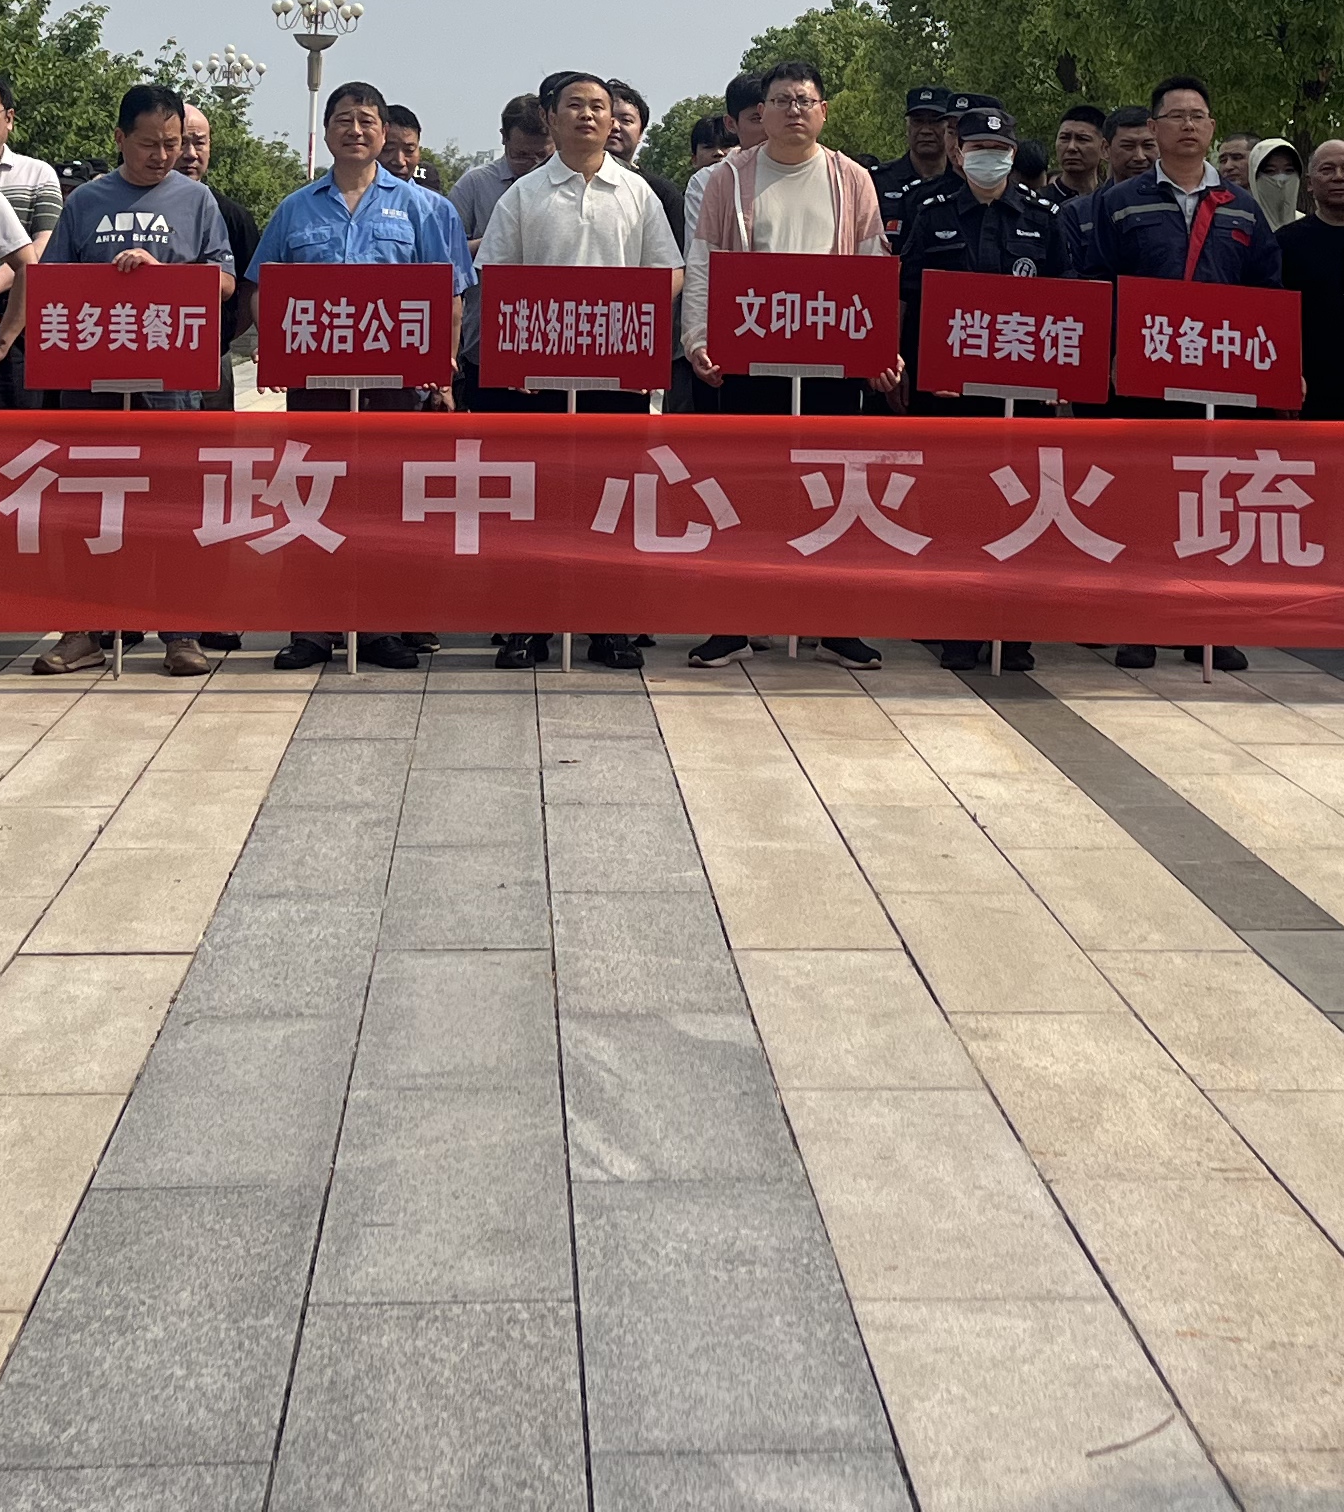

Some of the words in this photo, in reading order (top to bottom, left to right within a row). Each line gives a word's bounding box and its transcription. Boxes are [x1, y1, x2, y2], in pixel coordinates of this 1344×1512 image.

[39, 302, 207, 351] 美多美餐厅
[281, 297, 431, 354] 保洁公司
[498, 298, 655, 357] 江淮公务用车有限公司
[734, 288, 873, 341] 文印中心
[946, 308, 1084, 367] 档案馆
[1141, 314, 1278, 371] 设备中心
